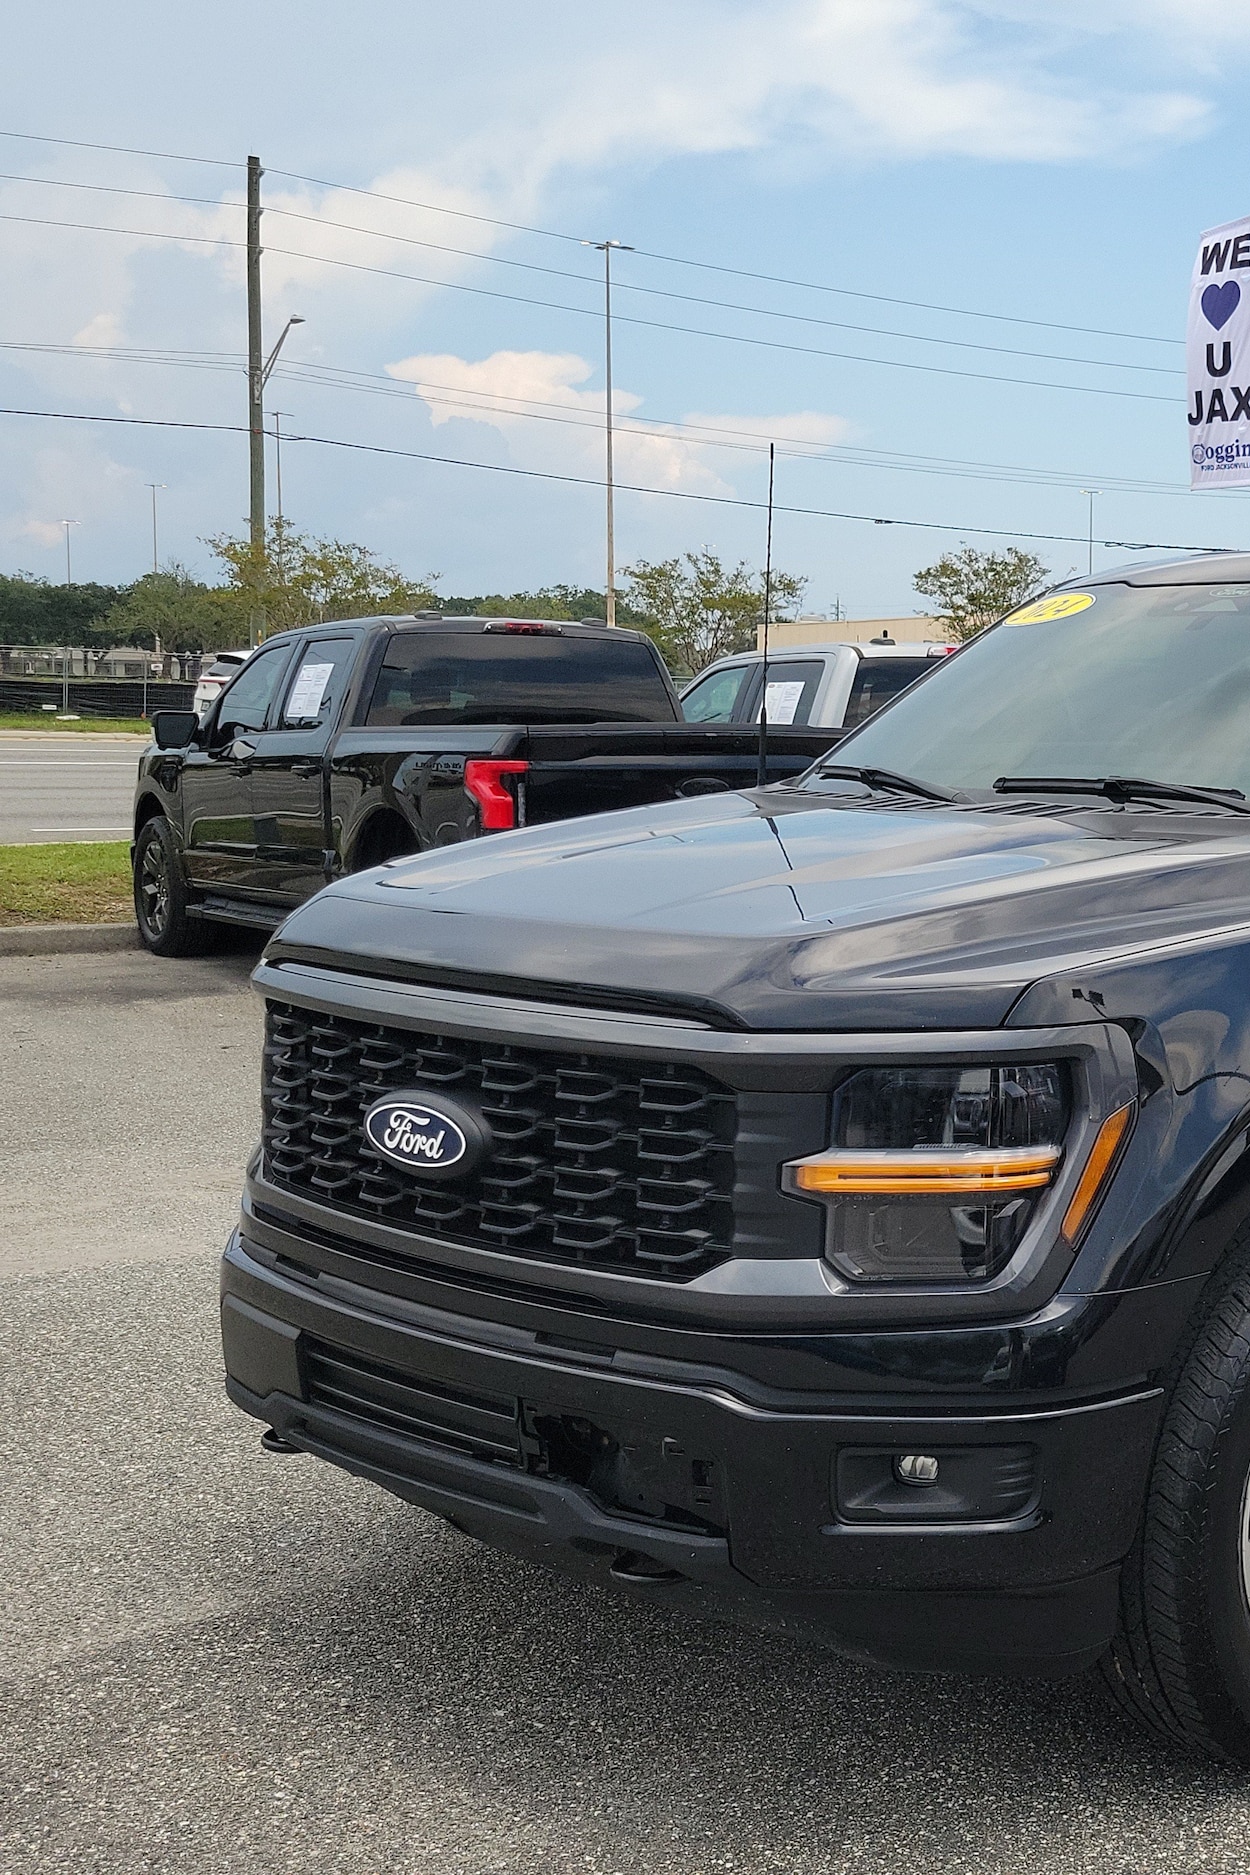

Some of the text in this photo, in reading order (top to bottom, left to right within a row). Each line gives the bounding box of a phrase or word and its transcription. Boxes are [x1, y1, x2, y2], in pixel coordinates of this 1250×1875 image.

[1200, 233, 1250, 276] WE
[1206, 341, 1231, 377] U
[384, 1110, 445, 1159] Ford
